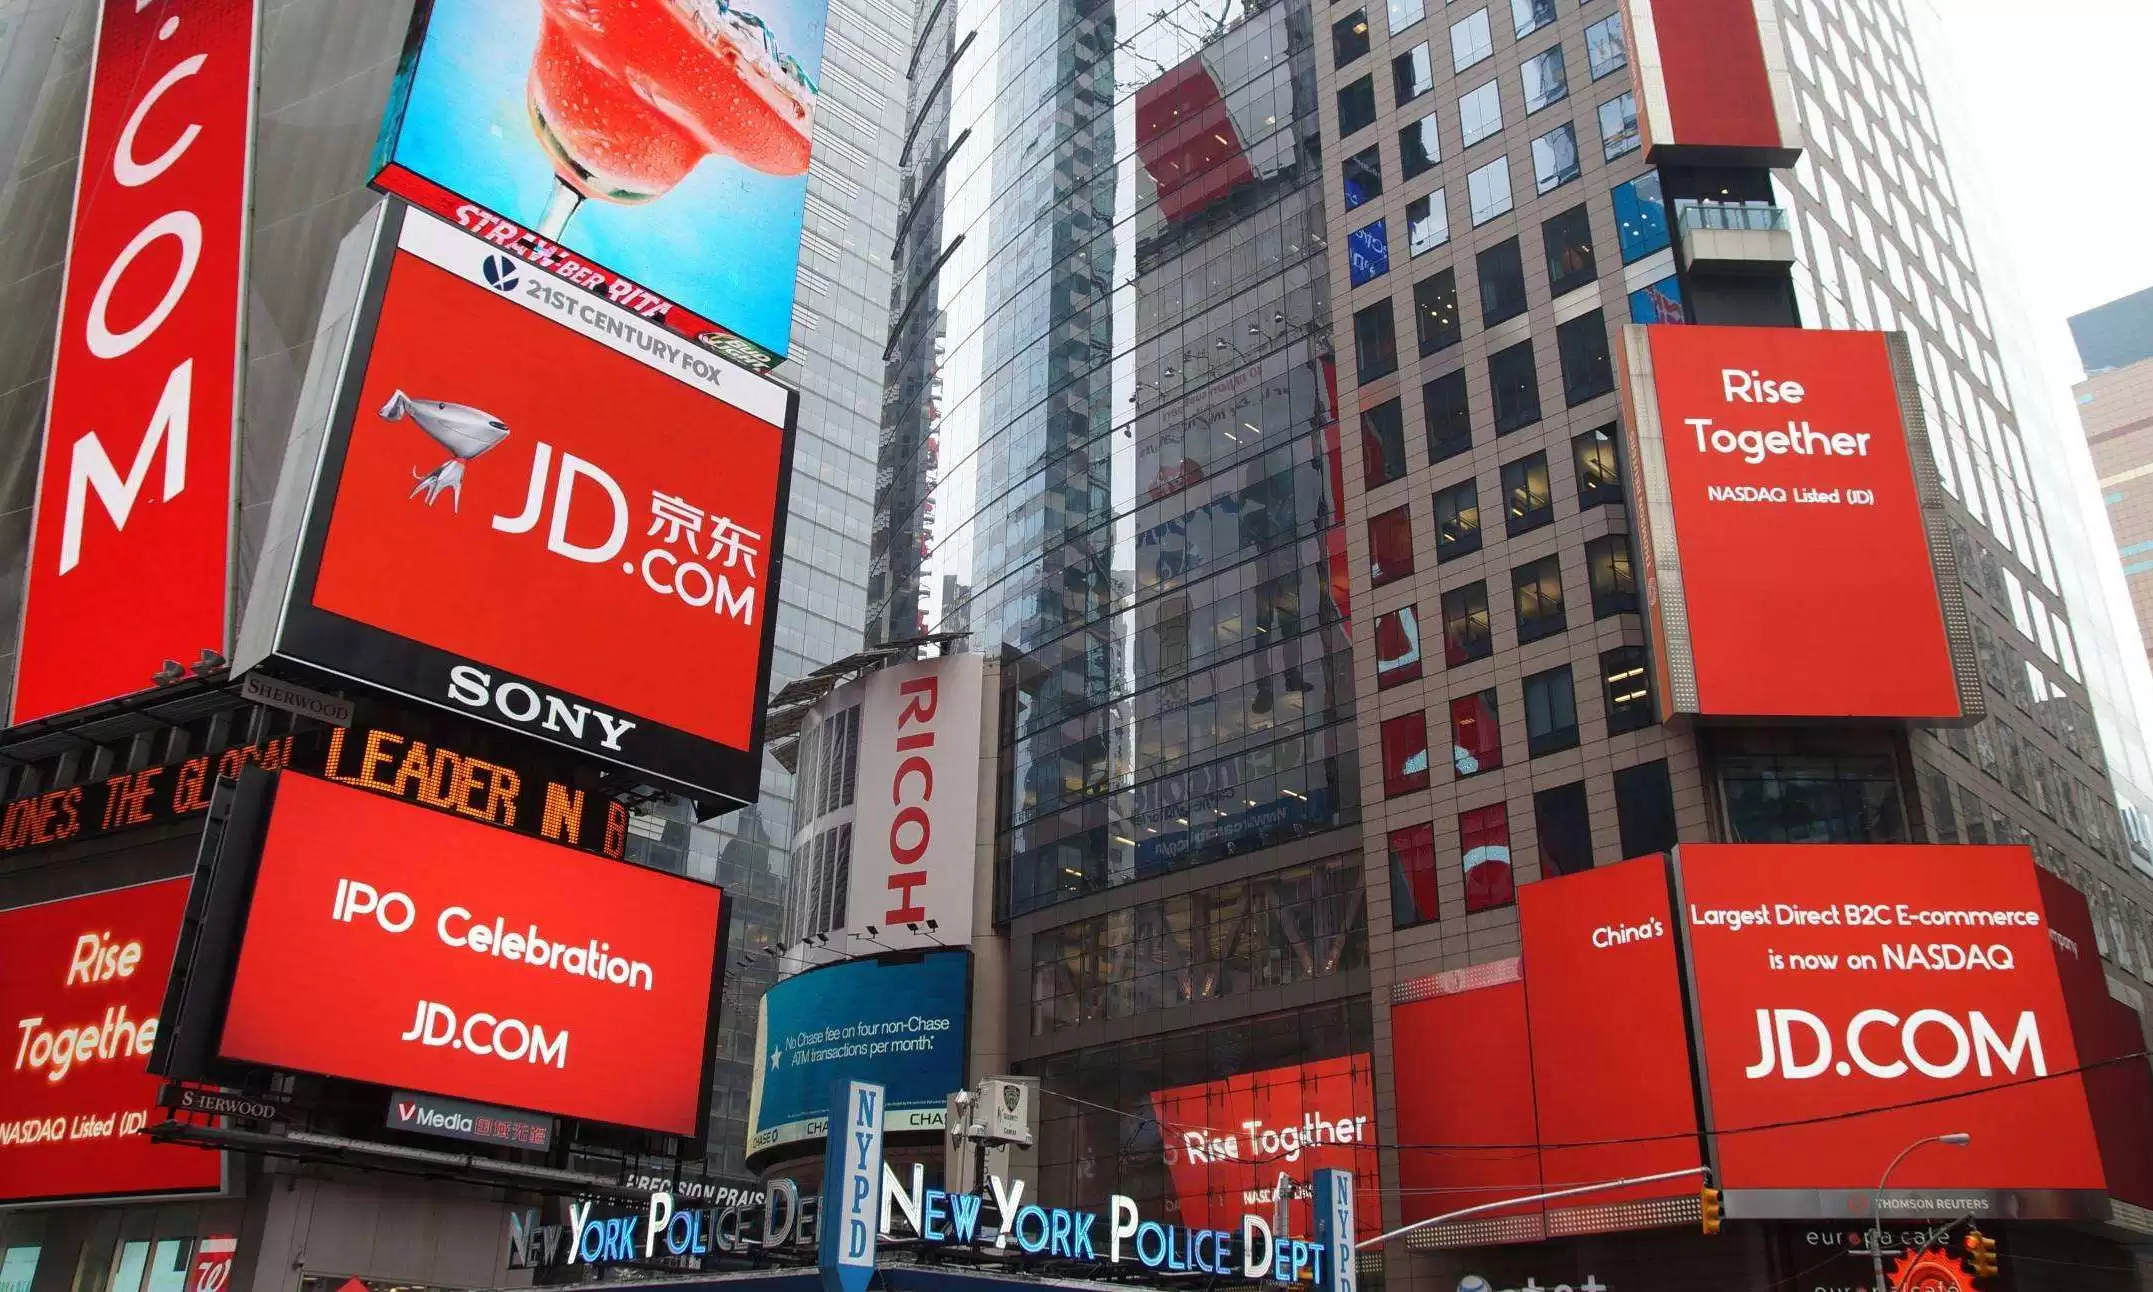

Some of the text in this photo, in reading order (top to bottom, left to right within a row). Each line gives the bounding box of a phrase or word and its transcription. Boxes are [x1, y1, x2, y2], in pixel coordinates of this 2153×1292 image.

[60, 0, 208, 576] .COM
[527, 279, 721, 386] 21ST CENTURY FOX
[1721, 368, 1805, 404] Rise
[1684, 418, 1871, 464] Together
[1707, 485, 1787, 503] NASDAQ
[1793, 487, 1840, 504] Listed
[647, 489, 762, 579] 京东
[248, 679, 349, 721] SHERWOOD
[447, 664, 637, 752] SONY
[102, 767, 165, 830] THE
[324, 726, 521, 827] LEADER
[884, 675, 939, 927] RICOH
[332, 878, 654, 992] IPO Celebration
[1591, 916, 1664, 950] China's
[1691, 903, 2040, 932] Largest Direct B2C E-commerce
[66, 930, 143, 986] Rise
[1768, 943, 2016, 972] is now on NASDAQ
[14, 1005, 160, 1083] Togethe
[401, 999, 570, 1069] JD.COM
[797, 1031, 824, 1047] Chase
[825, 1026, 840, 1041] fee
[842, 1027, 855, 1038] on
[857, 1021, 880, 1037] four
[881, 1015, 950, 1034] non-Chase
[810, 1042, 868, 1062] transactions
[870, 1041, 888, 1060] per
[1745, 1008, 2048, 1079] JD.COM
[0, 1116, 66, 1145] NASDAQ
[70, 1111, 116, 1140] Listed
[807, 1121, 829, 1135] CHA
[910, 1113, 949, 1126] CHA
[1242, 1111, 1367, 1162] Togther
[716, 1187, 767, 1208] PRAIS
[849, 1088, 877, 1259] NYPD
[507, 1207, 563, 1270] NEW
[567, 1200, 638, 1265] YORK
[645, 1190, 754, 1258] POLICE
[879, 1162, 984, 1243] NEW
[991, 1175, 1095, 1261] YORK
[1110, 1194, 1232, 1275] POLICE
[1243, 1213, 1326, 1286] DEPT
[1876, 1198, 1989, 1211] THOMSON REUTERS
